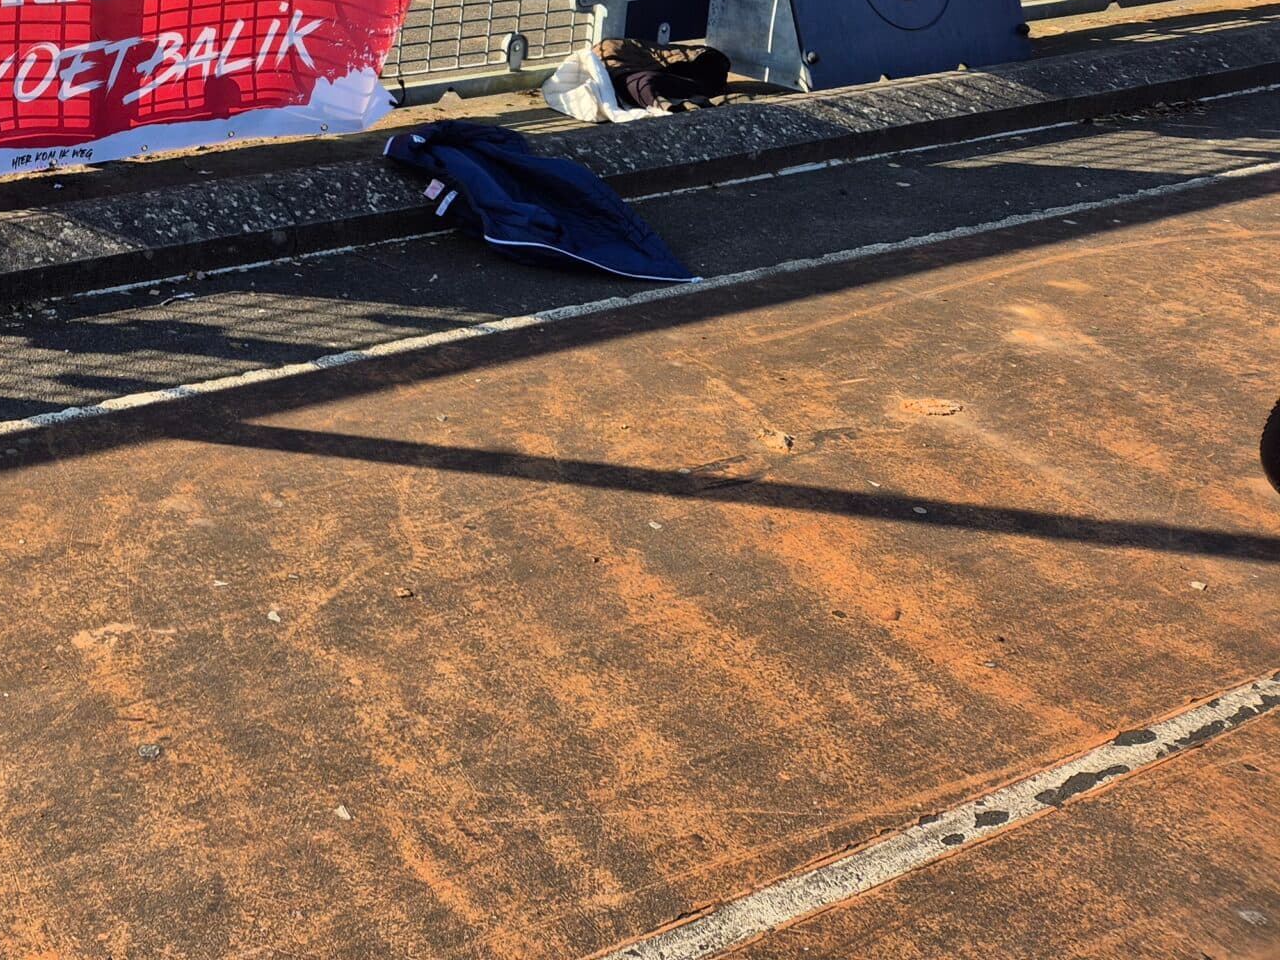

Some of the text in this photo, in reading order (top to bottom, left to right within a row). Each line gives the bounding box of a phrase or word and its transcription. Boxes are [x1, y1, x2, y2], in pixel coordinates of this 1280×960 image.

[11, 148, 93, 169] HIER KOM IK WEG
